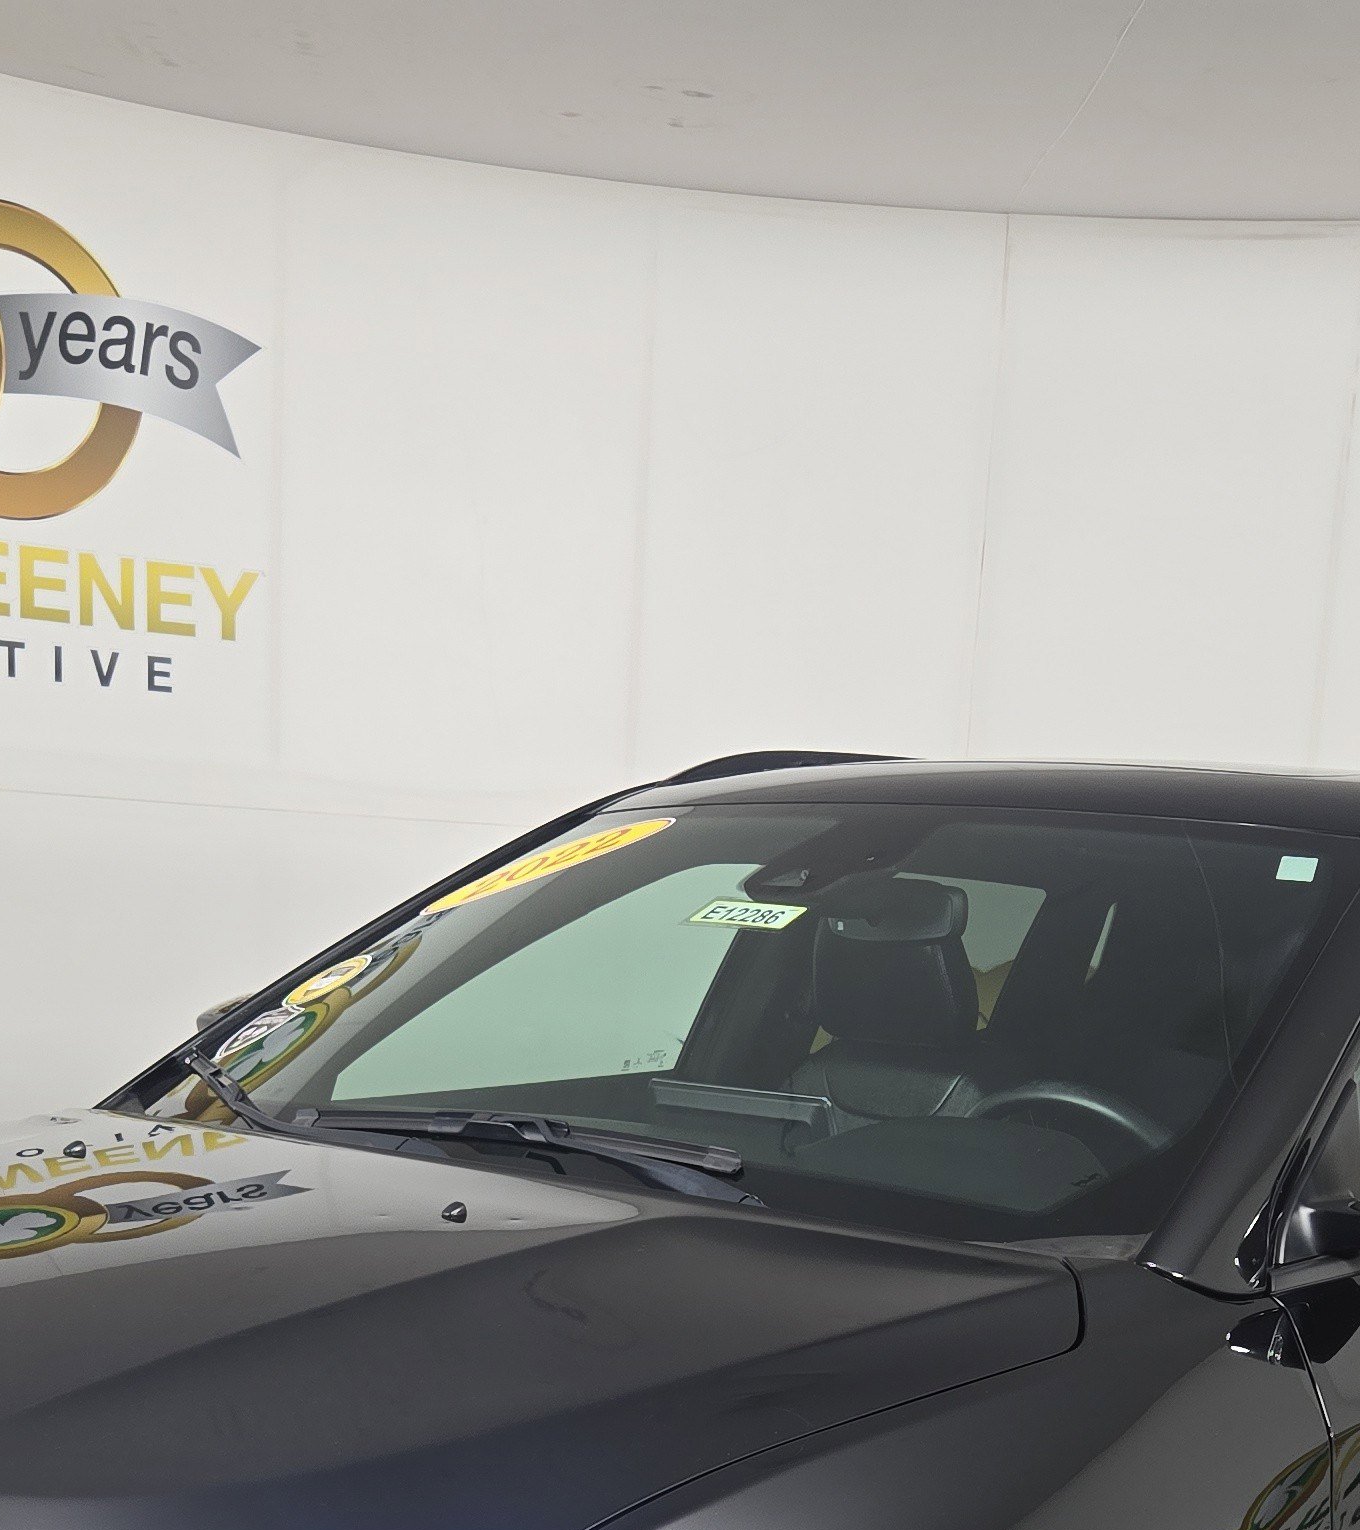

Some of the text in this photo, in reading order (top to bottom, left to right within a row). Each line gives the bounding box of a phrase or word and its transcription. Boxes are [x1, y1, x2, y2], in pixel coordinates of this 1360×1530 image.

[16, 309, 204, 391] years
[460, 828, 632, 901] 2022
[700, 905, 786, 925] E12286
